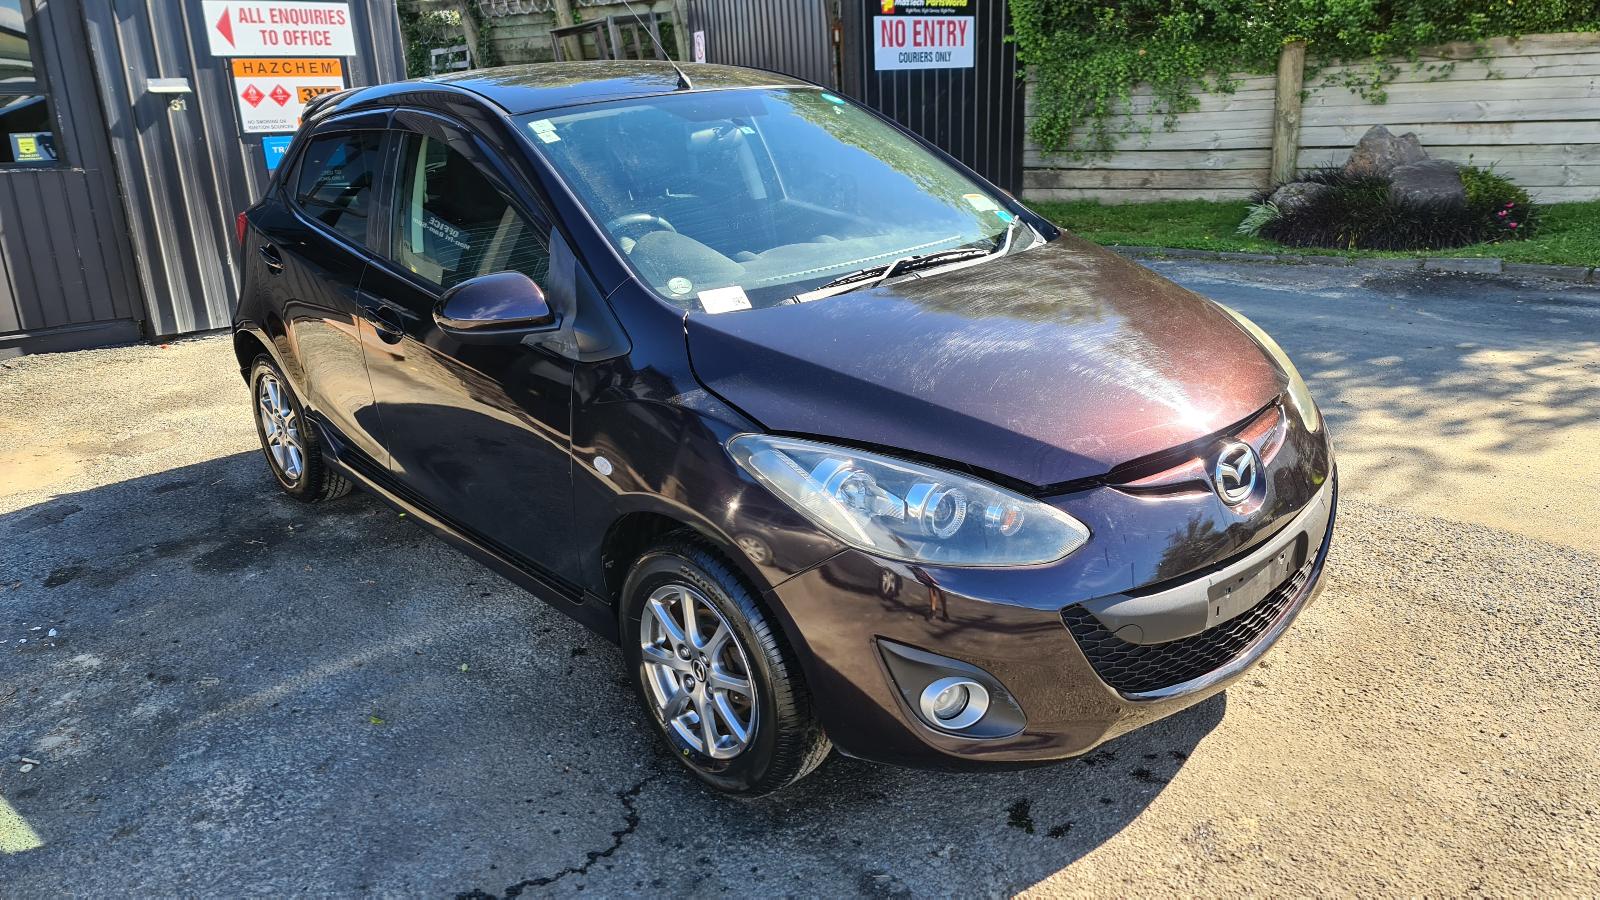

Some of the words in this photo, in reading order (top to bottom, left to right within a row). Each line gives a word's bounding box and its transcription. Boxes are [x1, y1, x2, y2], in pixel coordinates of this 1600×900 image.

[239, 7, 265, 24] ALL
[269, 8, 346, 26] ENQUIRIES
[259, 30, 279, 46] TO
[284, 30, 332, 46] OFFICE
[881, 20, 906, 48] NO
[913, 20, 967, 47] ENTRY
[898, 52, 933, 63] COURIERS
[935, 51, 952, 62] ONLY
[243, 62, 333, 74] HAZCHEM
[272, 146, 287, 154] TR
